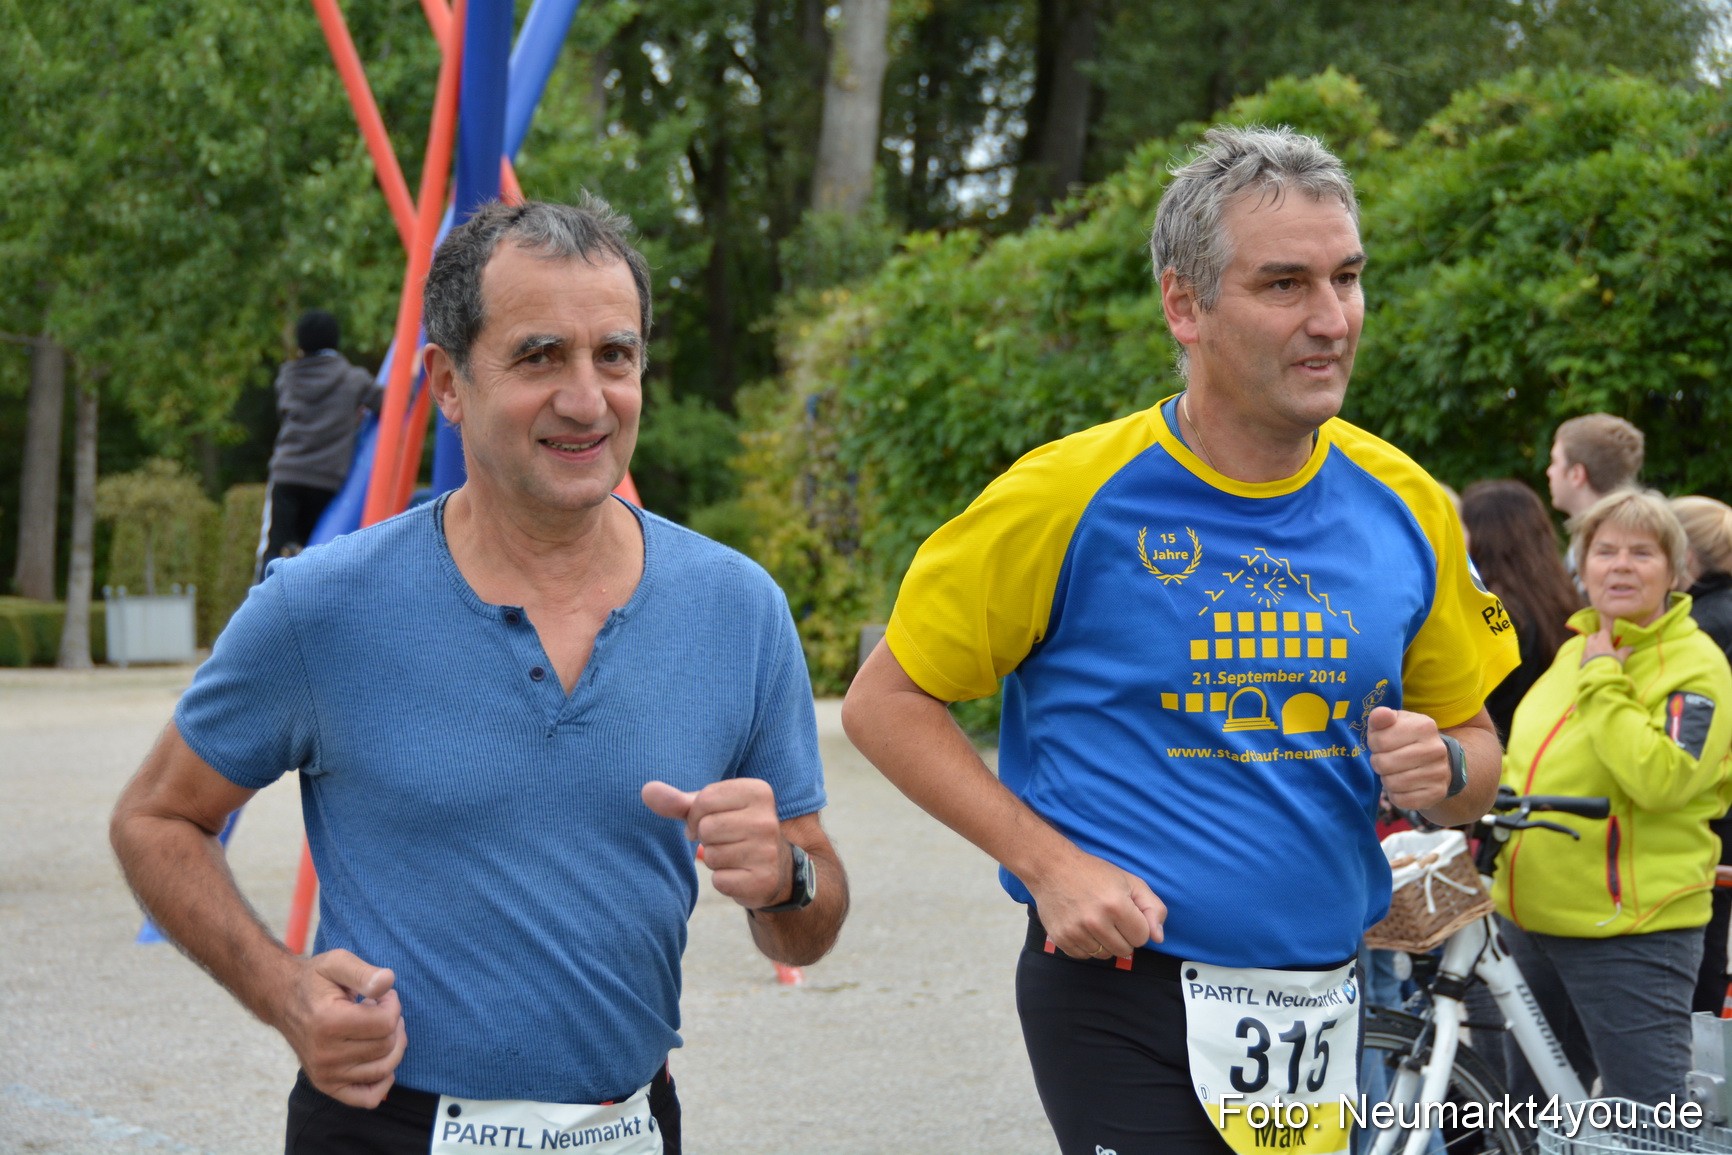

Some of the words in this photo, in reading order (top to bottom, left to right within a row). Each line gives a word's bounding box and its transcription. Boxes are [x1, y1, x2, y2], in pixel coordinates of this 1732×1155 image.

[1160, 533, 1177, 544] 15
[1153, 549, 1189, 560] Jahre
[1192, 669, 1305, 687] 21.September
[1309, 670, 1347, 684] 2014
[1189, 982, 1260, 1006] PARTL
[1266, 988, 1343, 1008] Neumarkt
[1230, 1017, 1338, 1094] 315
[442, 1121, 533, 1149] PARTL
[540, 1115, 642, 1150] Neumarkt
